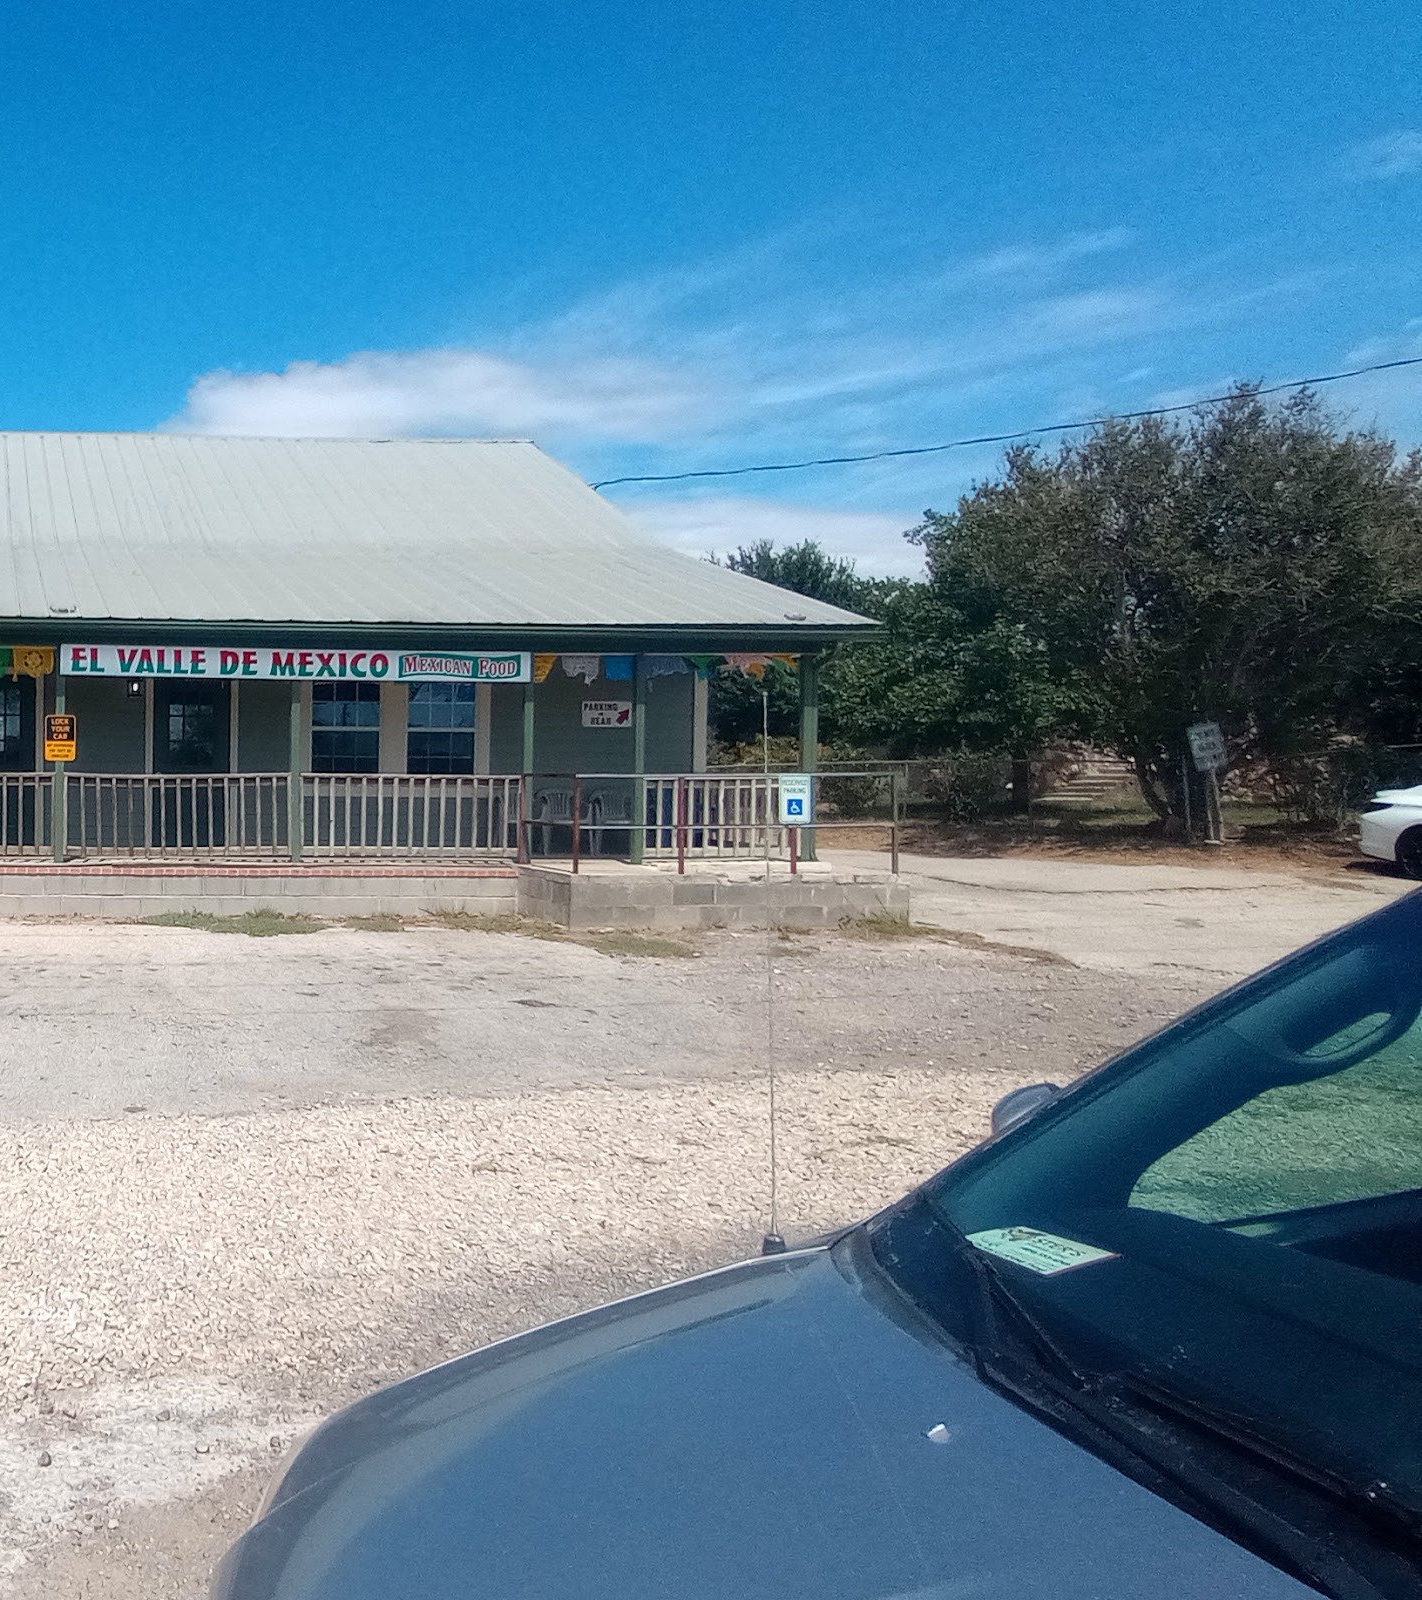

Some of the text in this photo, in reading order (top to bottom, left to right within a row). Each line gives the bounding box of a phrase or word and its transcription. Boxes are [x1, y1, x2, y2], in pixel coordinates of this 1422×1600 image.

[71, 647, 389, 677] EL VALLE DE MEXICO
[404, 655, 516, 677] MEXICAN FOOD
[583, 703, 619, 711] PARKING
